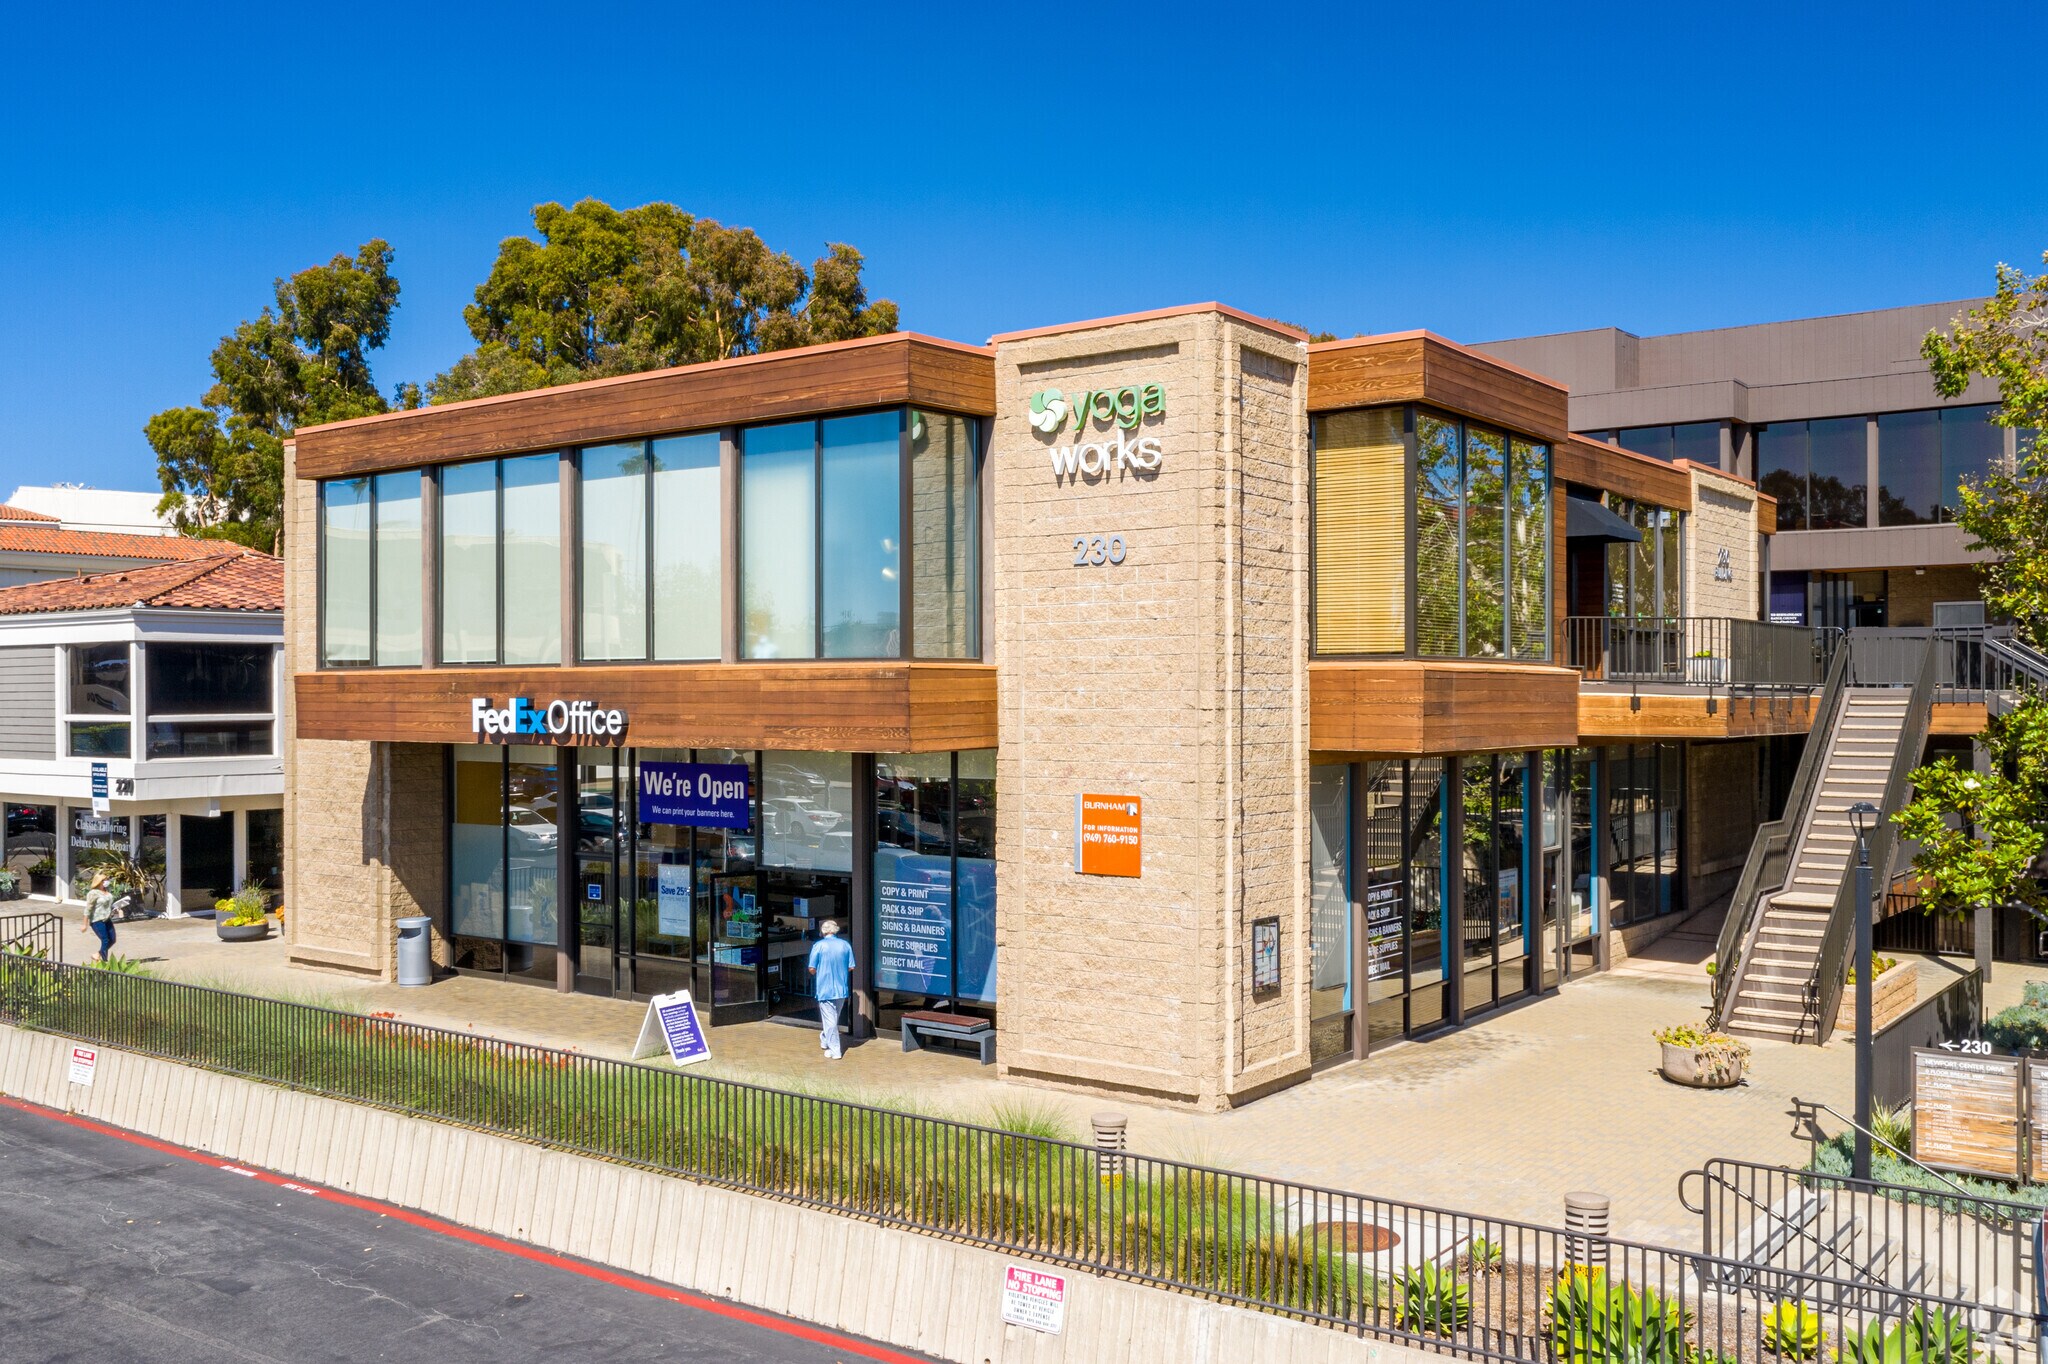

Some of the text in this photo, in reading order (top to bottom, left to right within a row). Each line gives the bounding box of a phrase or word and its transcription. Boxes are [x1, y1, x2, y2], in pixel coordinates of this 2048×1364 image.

[1071, 382, 1166, 430] yoga
[1049, 429, 1162, 475] works
[1073, 534, 1126, 566] 230
[472, 697, 625, 735] FedEx Office
[643, 771, 744, 805] We're Open
[652, 805, 735, 818] We can print your banners here.
[1083, 801, 1126, 810] BURNHAM
[75, 818, 127, 836] Classic Tailoring
[1097, 825, 1138, 833] INFORMATION
[71, 836, 92, 849] Deluxe
[93, 838, 108, 850] Shoe
[1083, 833, 1138, 845] (949) 760-9150
[661, 885, 676, 896] Save
[881, 886, 929, 899] COPY & PRINT
[1368, 891, 1377, 902] OPY
[1380, 889, 1393, 900] PRINT
[882, 904, 924, 916] PACK & SHIP
[1368, 910, 1376, 920] ACK
[1380, 907, 1390, 917] SHIP
[882, 921, 945, 936] SIGNS & BANNERS
[1382, 922, 1402, 935] BANNERS
[882, 938, 938, 953] OFFICE SUPPLIES
[1380, 941, 1398, 953] SUPPLIES
[882, 956, 924, 969] DIRECT MAIL
[1960, 1039, 1992, 1055] 230
[1925, 1059, 2005, 1073] NEWPORT CENTER DRIVE
[1013, 1271, 1057, 1289] FIRE LANE
[1008, 1280, 1061, 1300] NO STOPPING
